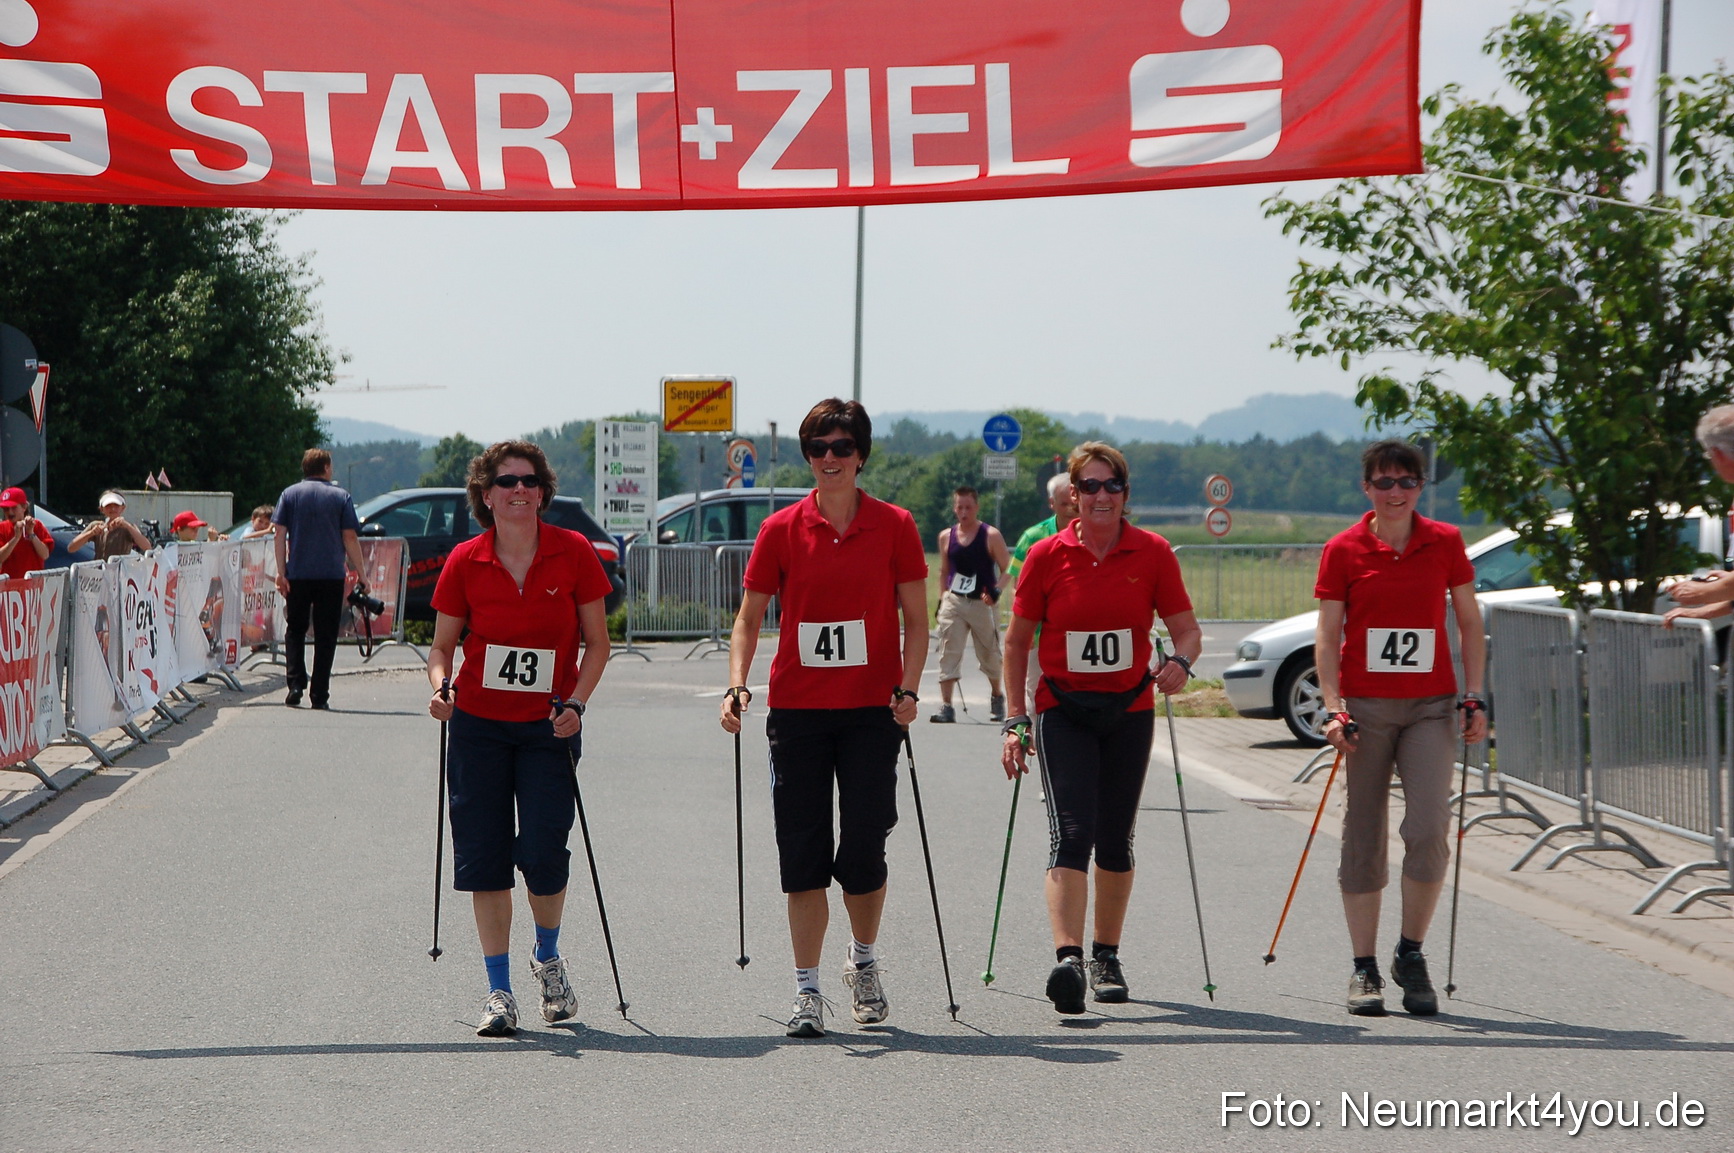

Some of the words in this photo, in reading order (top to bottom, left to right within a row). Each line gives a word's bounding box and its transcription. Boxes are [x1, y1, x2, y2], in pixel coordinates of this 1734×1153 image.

[1213, 484, 1227, 497] 60
[959, 577, 973, 591] 12
[814, 626, 846, 661] 41
[1081, 632, 1120, 667] 40
[1380, 632, 1420, 667] 42
[498, 650, 539, 687] 43
